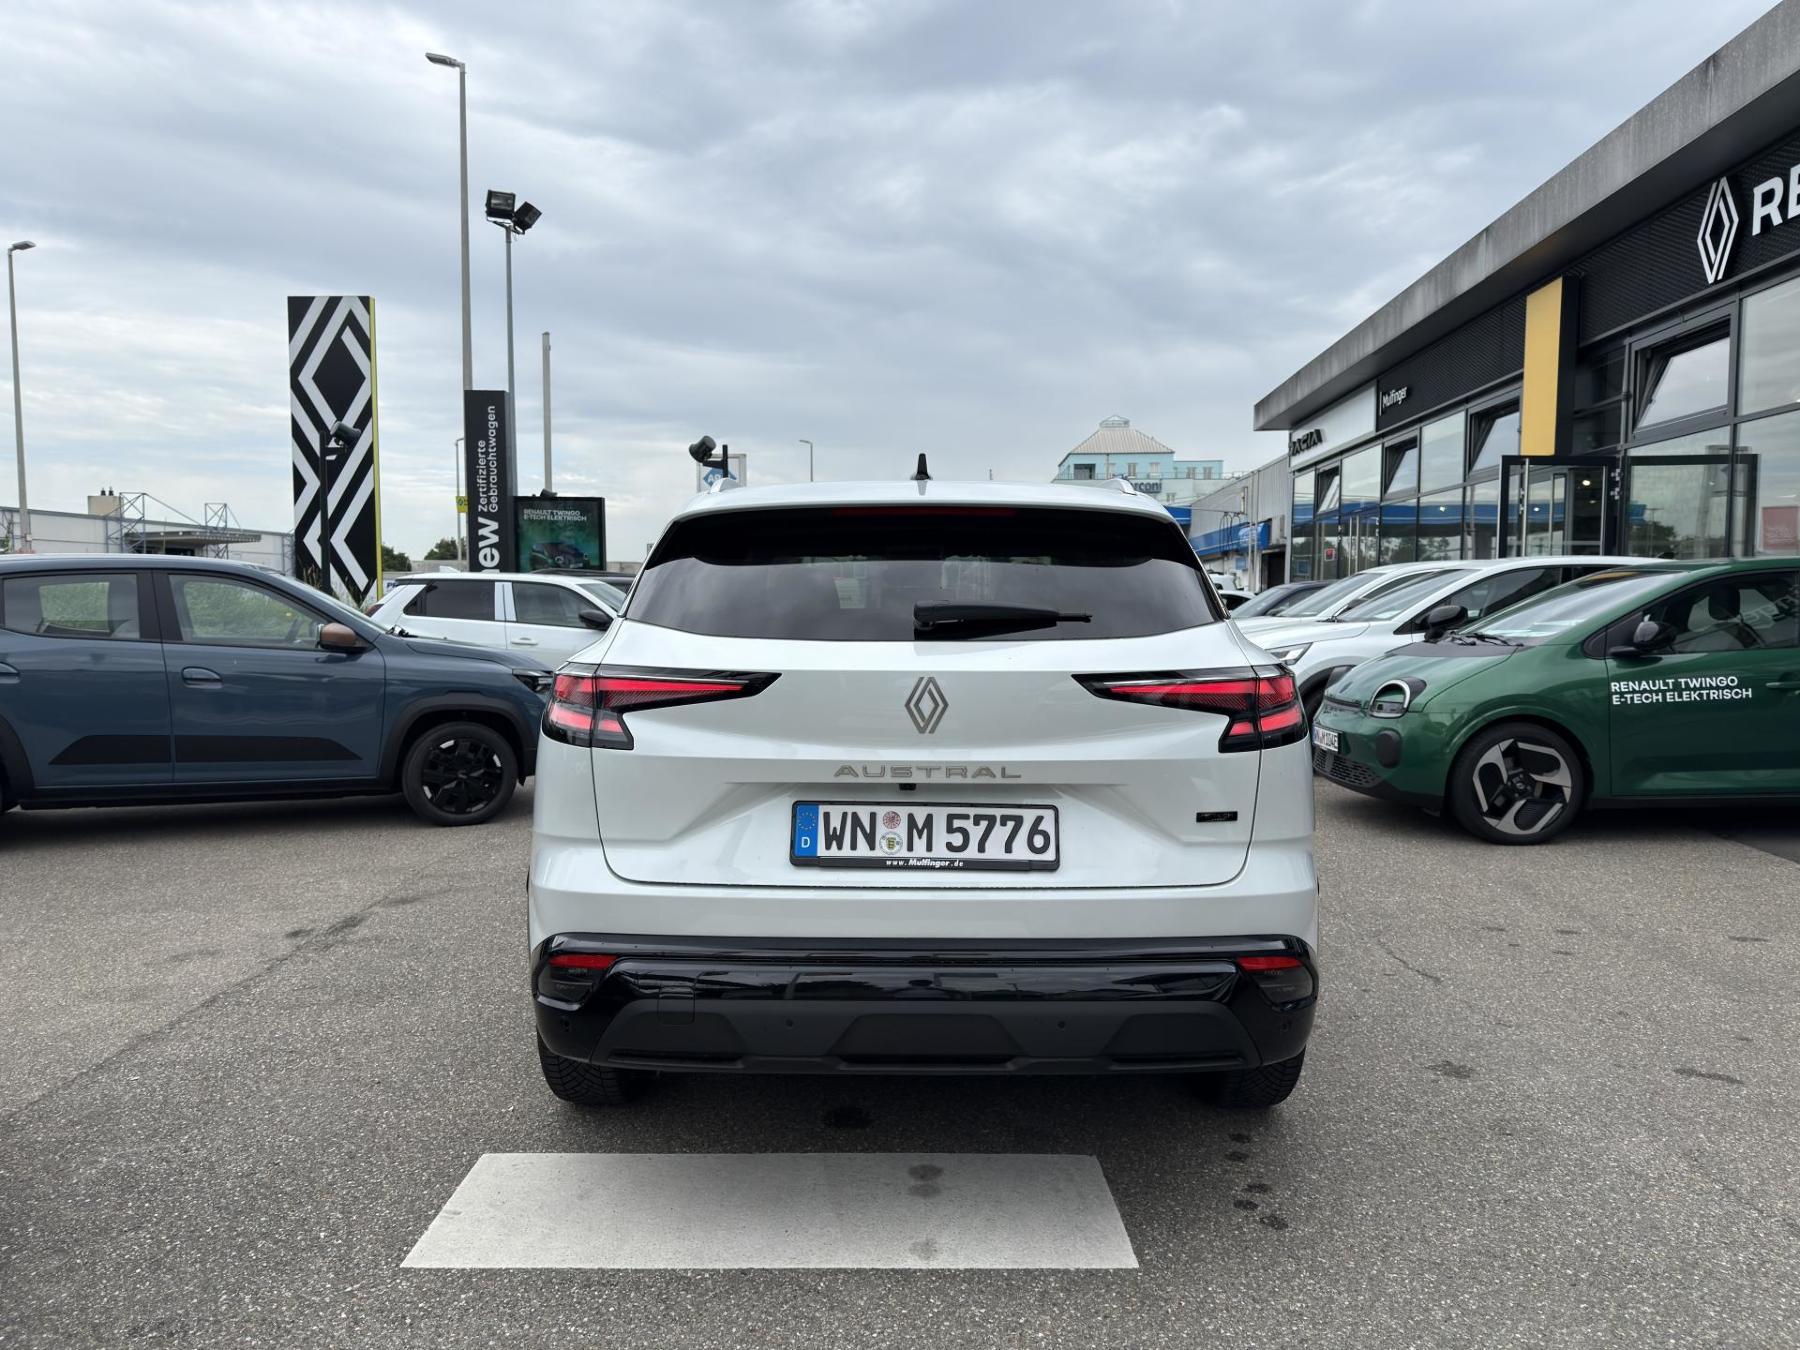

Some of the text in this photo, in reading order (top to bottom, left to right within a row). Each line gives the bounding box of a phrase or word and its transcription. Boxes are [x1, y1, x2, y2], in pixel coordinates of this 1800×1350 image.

[487, 405, 499, 513] Gebrauchtwagen
[477, 440, 487, 512] Zertifizierte
[478, 516, 500, 573] ew
[1610, 676, 1738, 693] RENAULT TWINGO
[1612, 688, 1753, 705] E-TECH ELEKTRISCH
[834, 765, 1022, 779] AUSTRAL
[801, 837, 811, 848] D
[823, 811, 877, 851] WN
[906, 813, 934, 852] M
[945, 814, 1051, 854] 5776
[886, 858, 964, 868] www.Mulfinger.de
